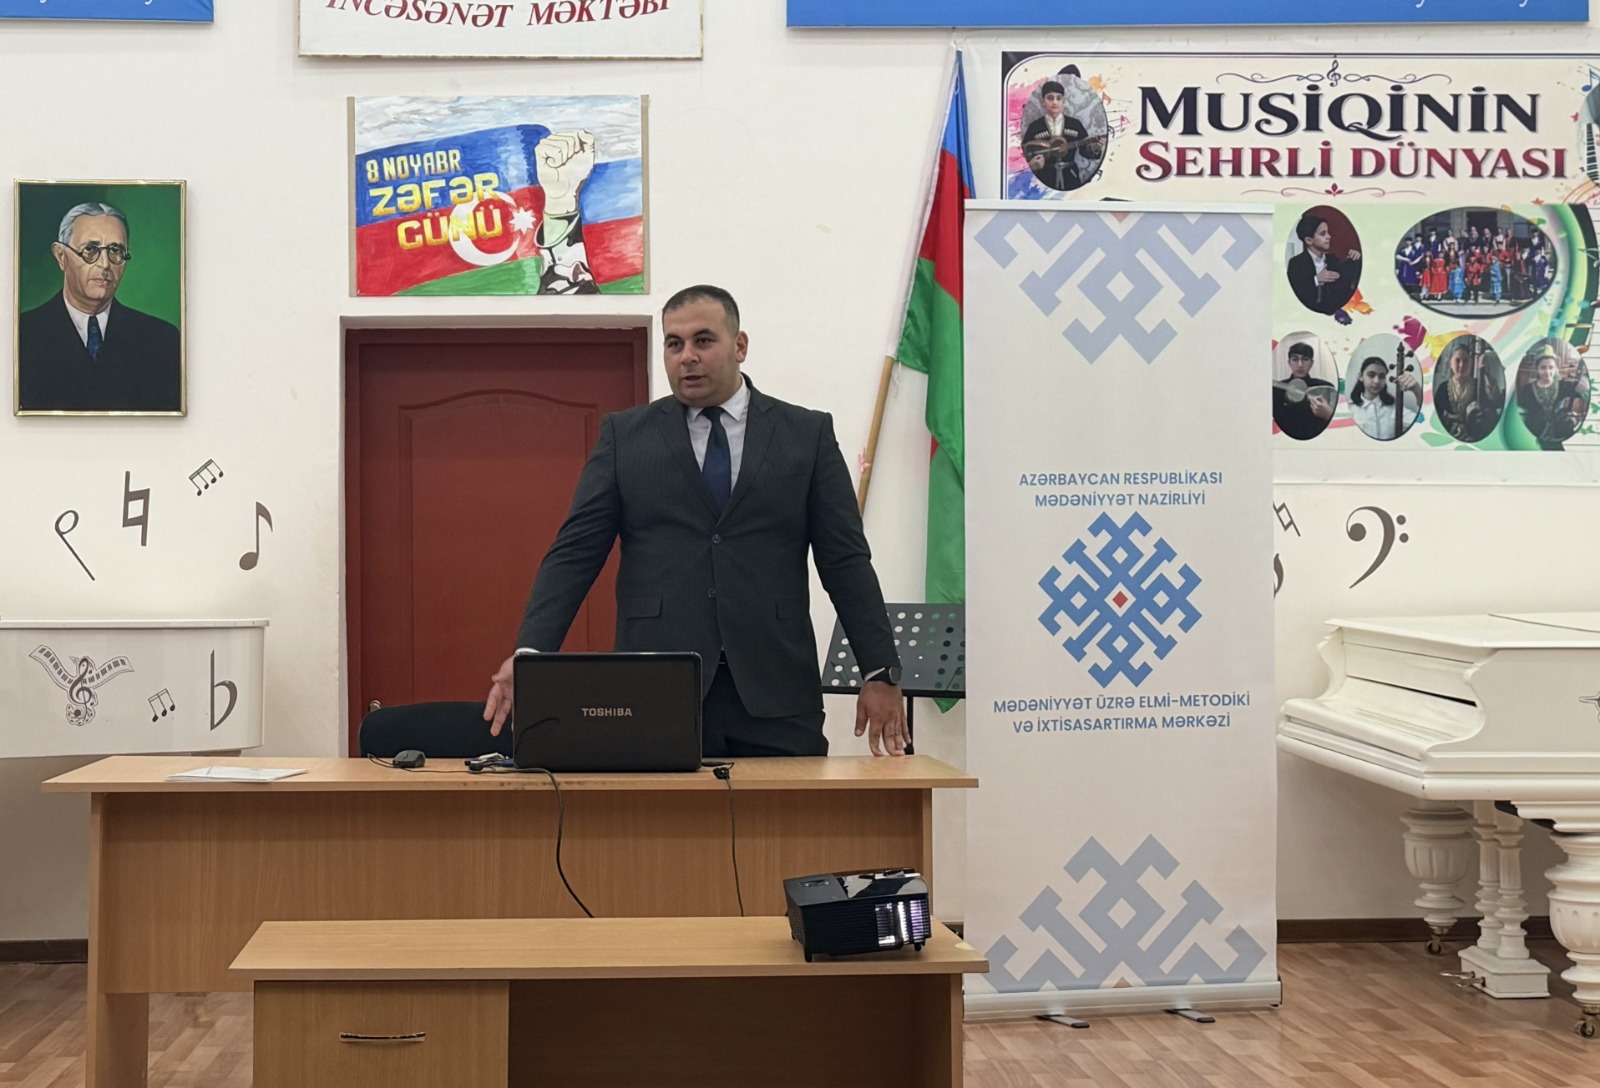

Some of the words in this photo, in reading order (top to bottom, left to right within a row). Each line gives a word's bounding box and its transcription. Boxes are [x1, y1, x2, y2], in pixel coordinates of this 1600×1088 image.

[1135, 84, 1541, 141] MUSİQİNİN
[366, 159, 379, 183] 8
[382, 149, 462, 181] NOYABR
[1135, 140, 1336, 182] SEHRLİ
[1350, 141, 1568, 179] DÜNYASI
[369, 172, 499, 217] ZƏFƏR
[397, 204, 503, 250] GÜNÜ
[1019, 473, 1120, 486] AZƏRBAYCAN
[1124, 470, 1223, 485] RESPUBLİKASI
[1035, 491, 1135, 507] MƏDƏNİYYƏT
[1138, 490, 1206, 506] NAZİRLİYİ
[582, 707, 633, 717] TOSHIBA
[994, 695, 1092, 713] MƏDƏNİYYƏT
[1096, 694, 1136, 709] ÜZRƏ
[1139, 691, 1250, 708] ELMİ-METODİKİ
[1013, 720, 1034, 734] VƏ
[1037, 717, 1158, 733] İXTİSASARTIRMA
[1162, 712, 1231, 729] MƏRKƏZİ
